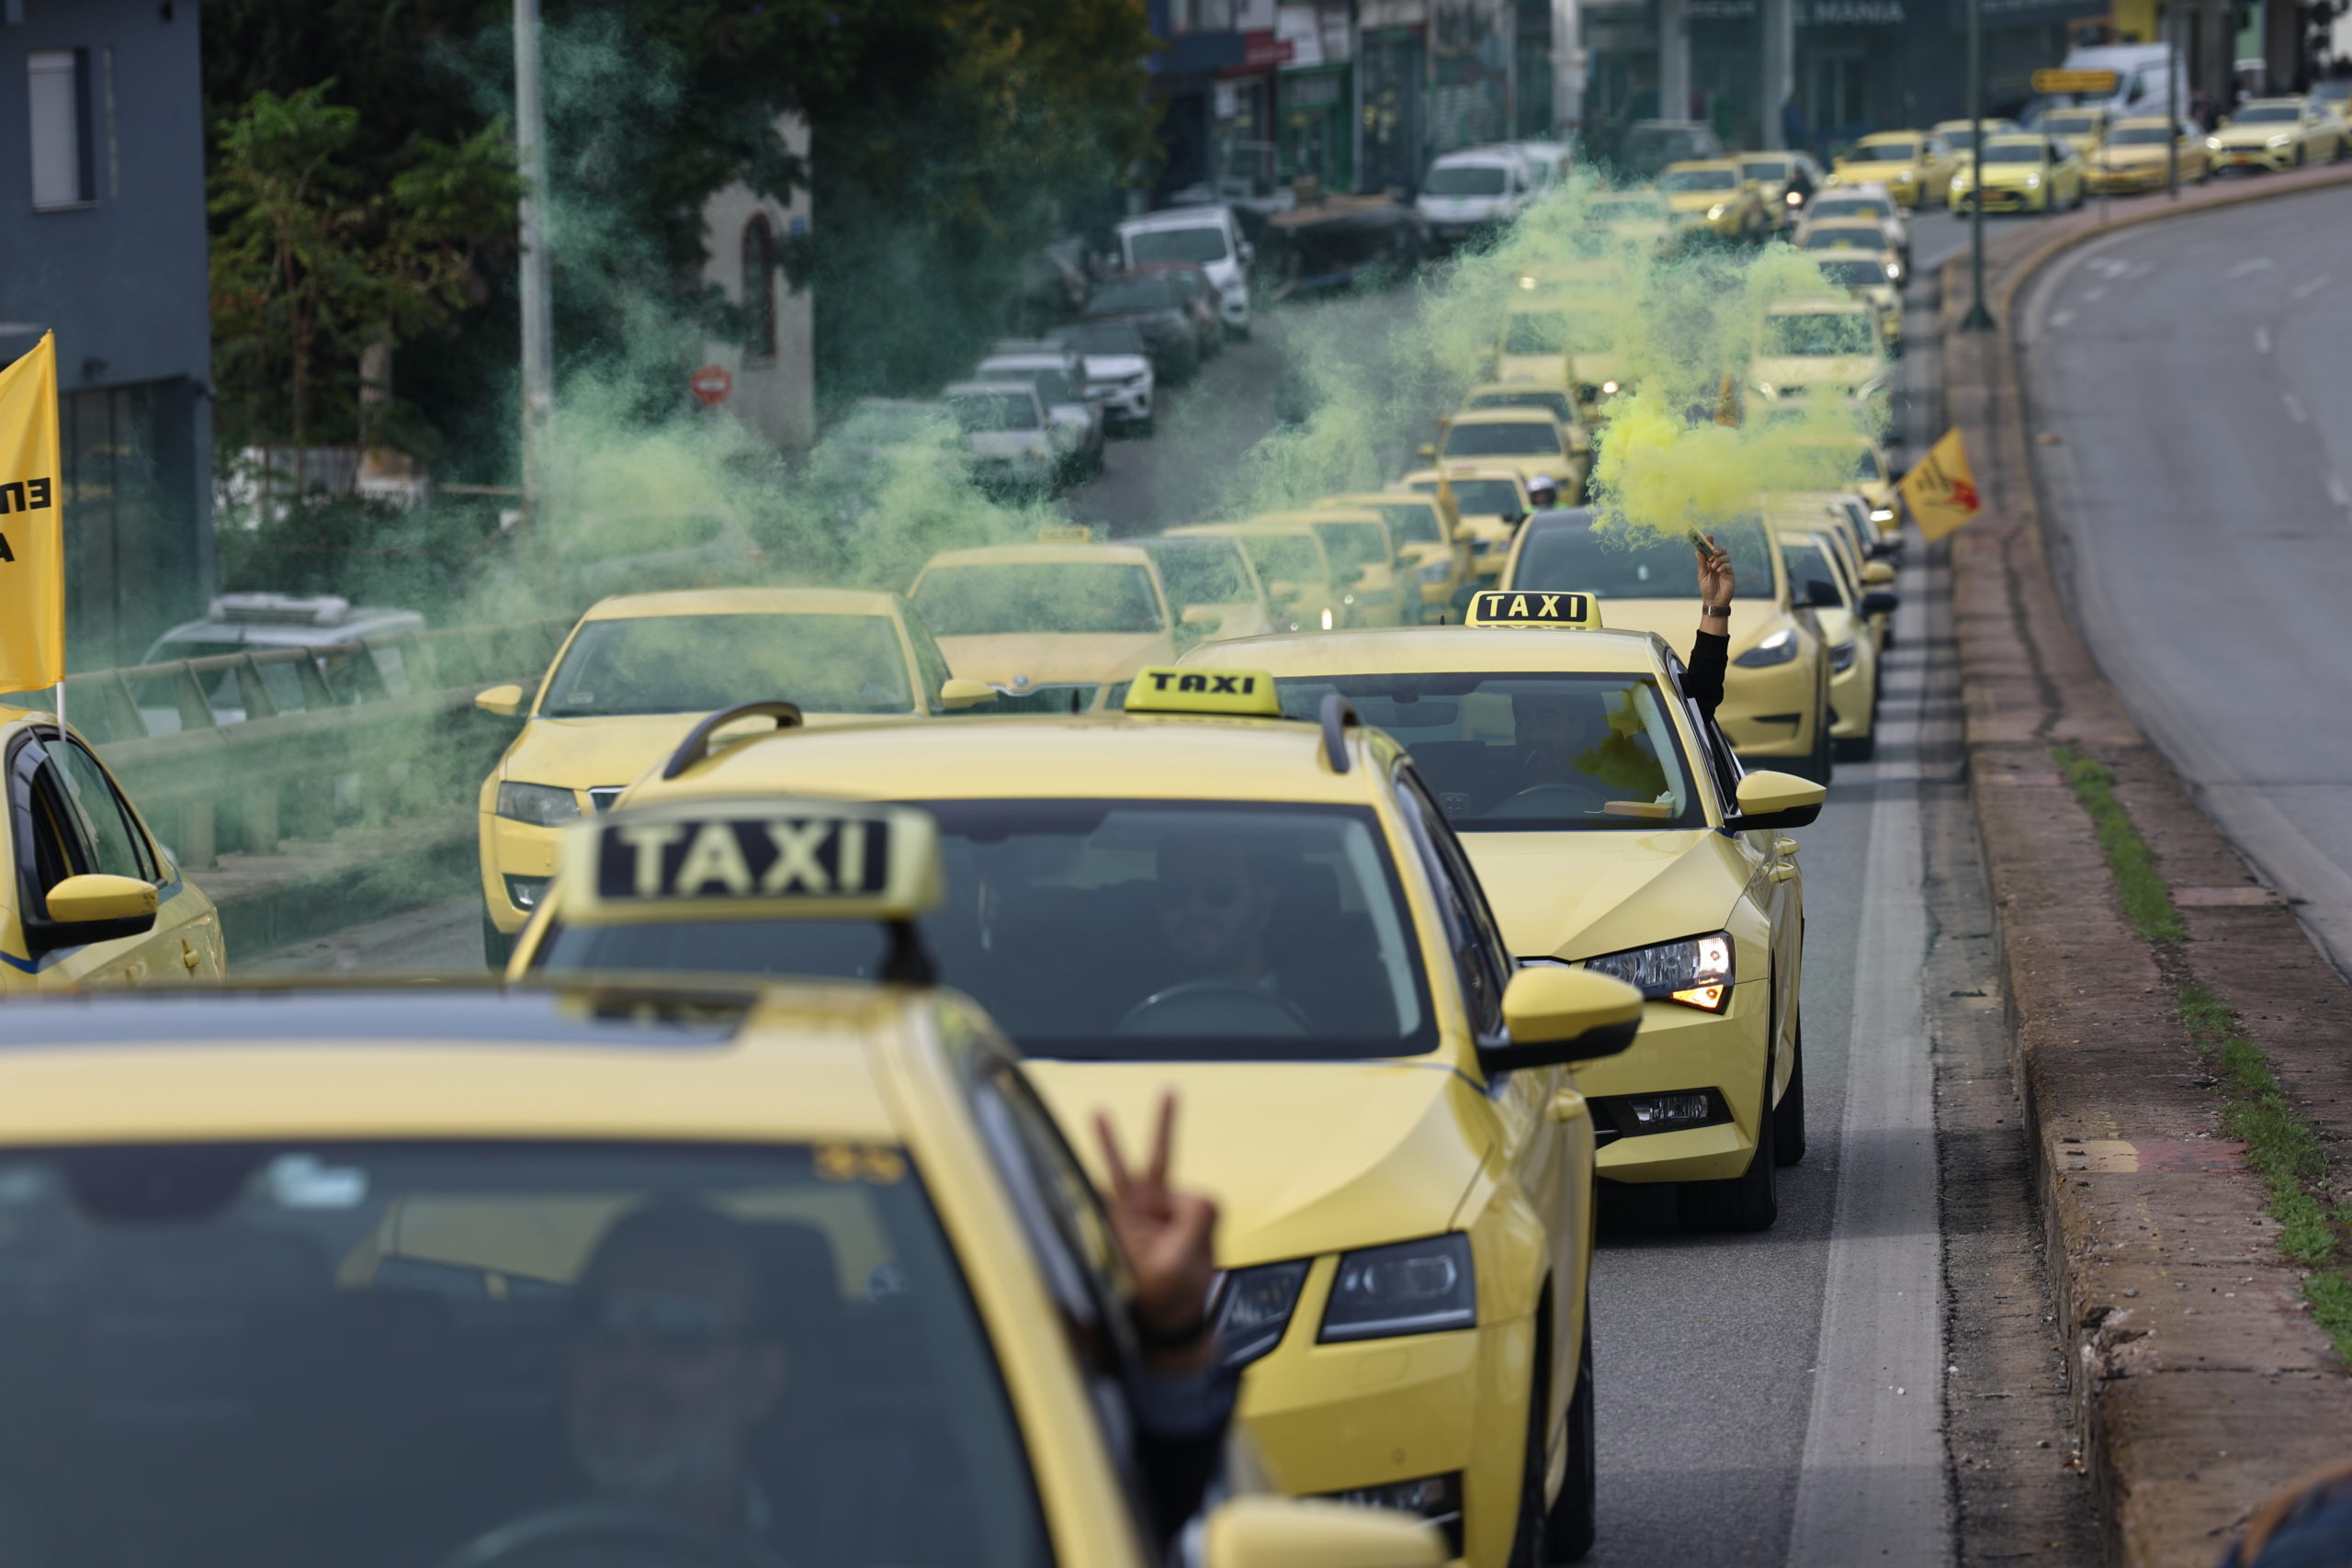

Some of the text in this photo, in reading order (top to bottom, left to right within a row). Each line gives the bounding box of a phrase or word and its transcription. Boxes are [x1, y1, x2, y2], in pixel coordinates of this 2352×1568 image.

[1487, 595, 1578, 617] TAXI
[1149, 673, 1255, 694] TAXI
[616, 820, 865, 897] TAXI
